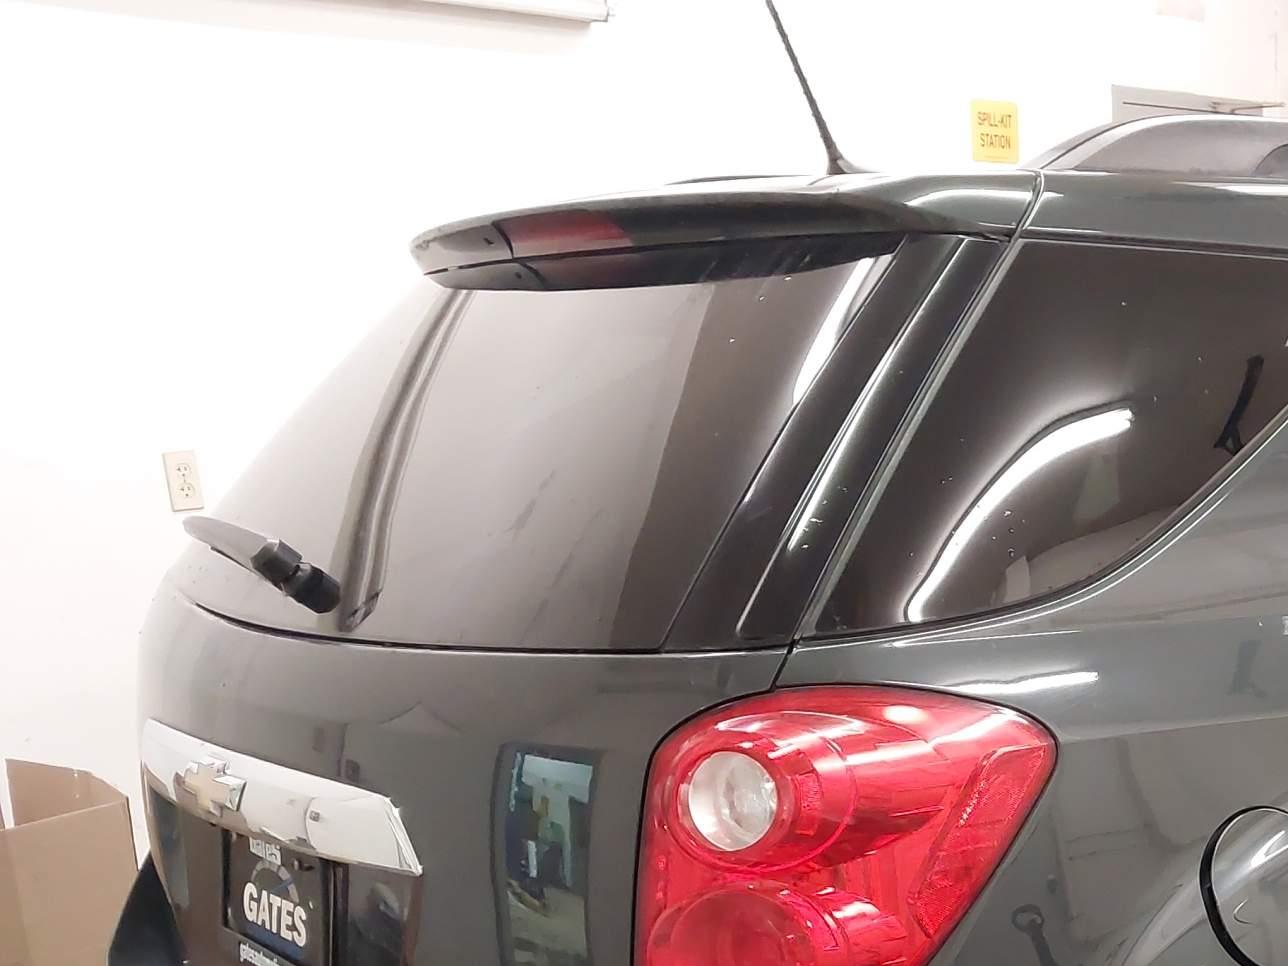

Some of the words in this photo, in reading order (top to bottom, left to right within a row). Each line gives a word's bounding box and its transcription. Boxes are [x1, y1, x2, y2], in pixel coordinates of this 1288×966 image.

[977, 111, 1012, 128] SPILL-KIT
[980, 132, 1011, 150] STATION
[243, 882, 307, 947] GATES
